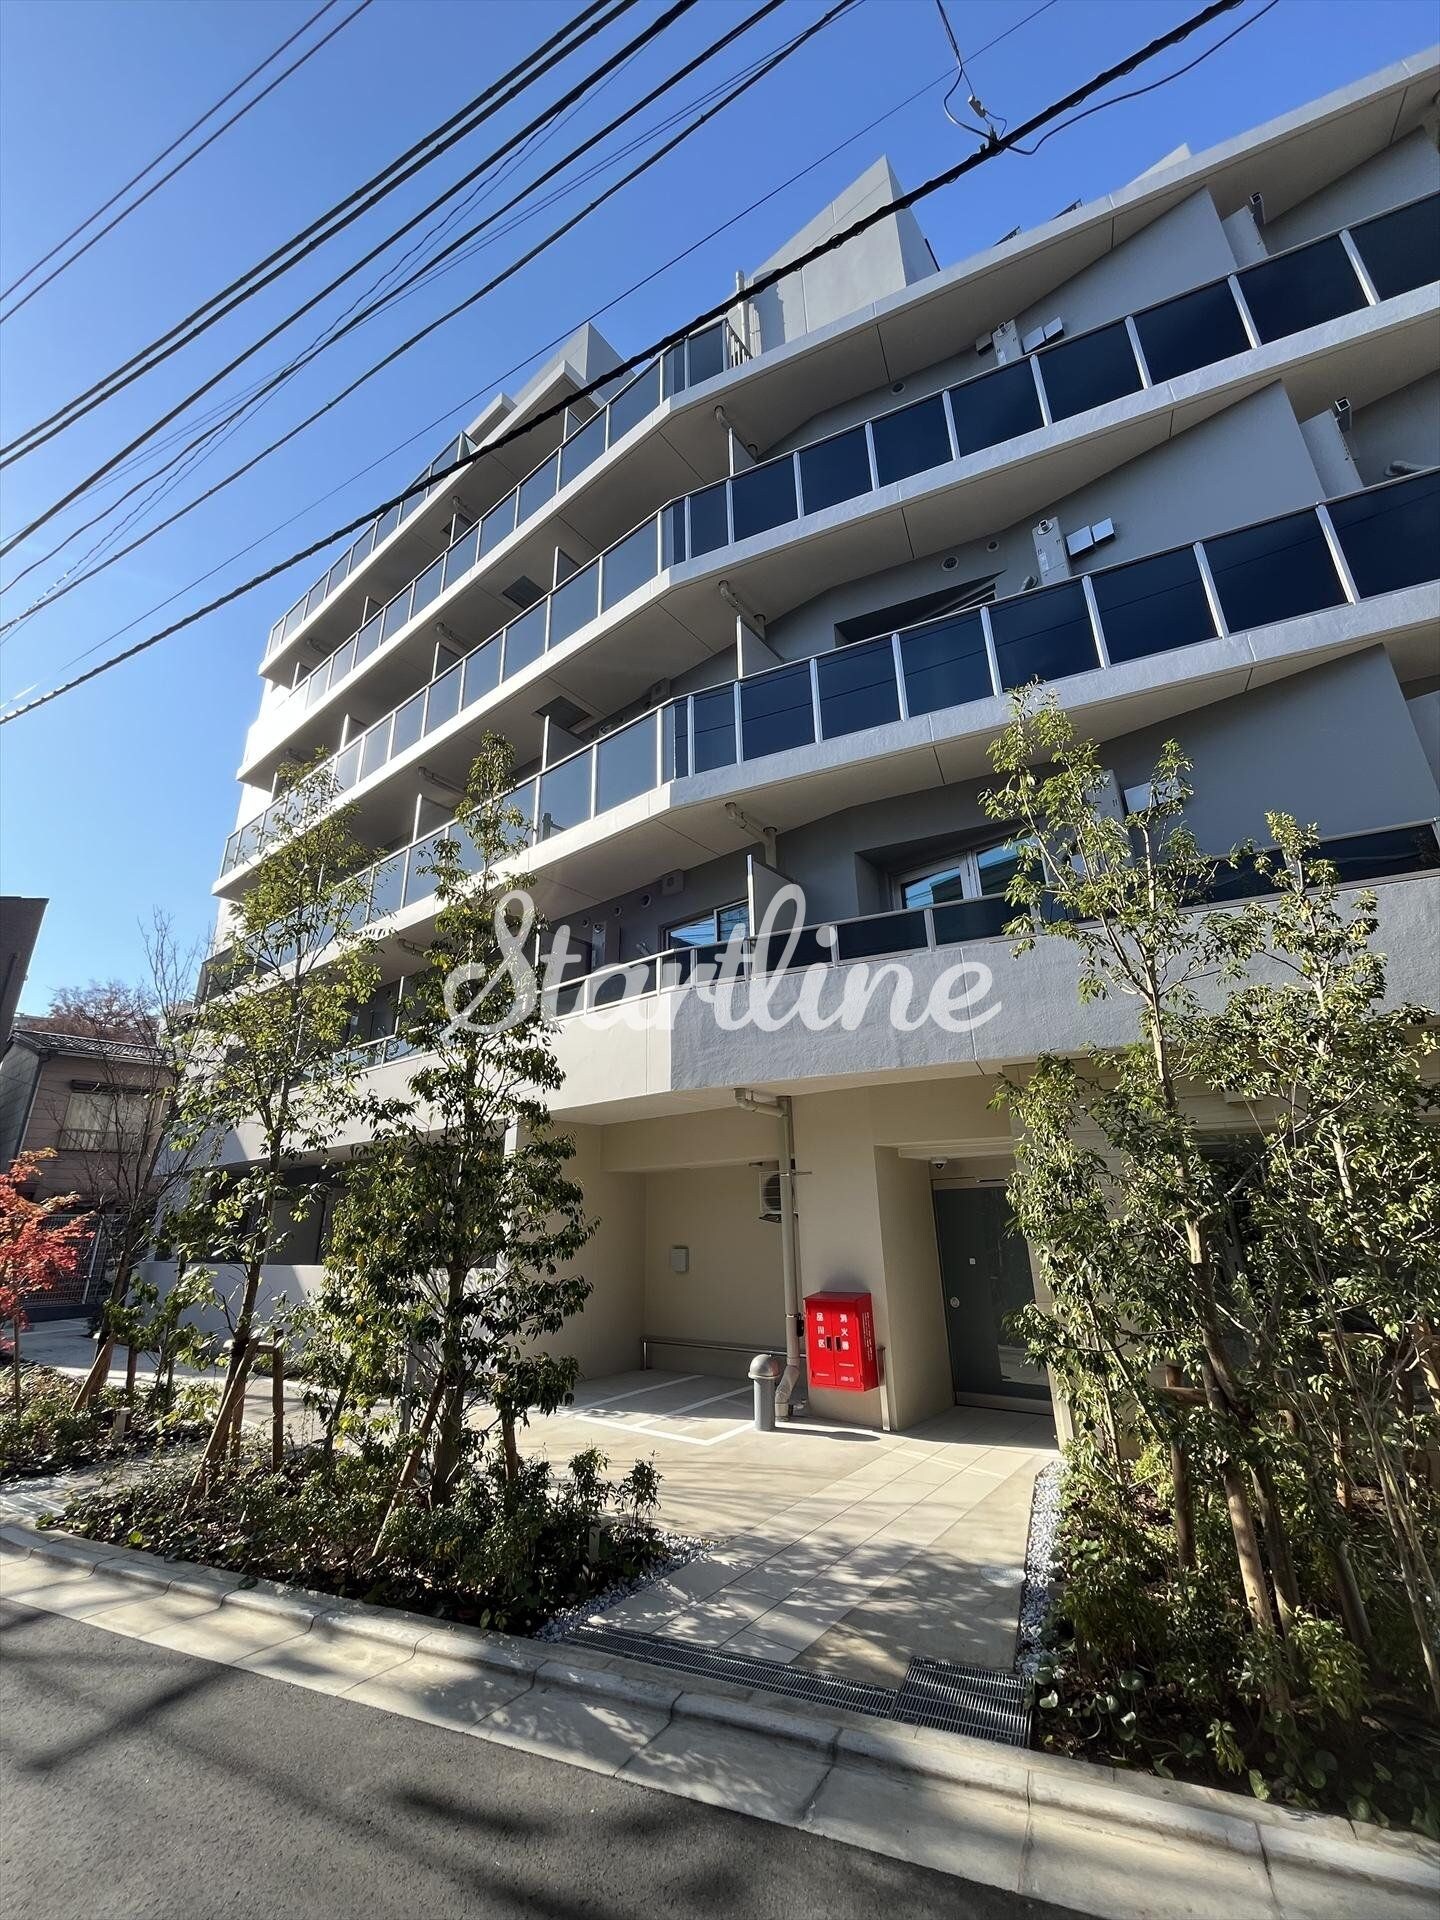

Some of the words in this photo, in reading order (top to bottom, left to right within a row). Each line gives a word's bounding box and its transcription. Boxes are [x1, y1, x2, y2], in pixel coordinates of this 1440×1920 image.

[816, 1312, 825, 1348] 品川区
[840, 1313, 850, 1350] 消火器
